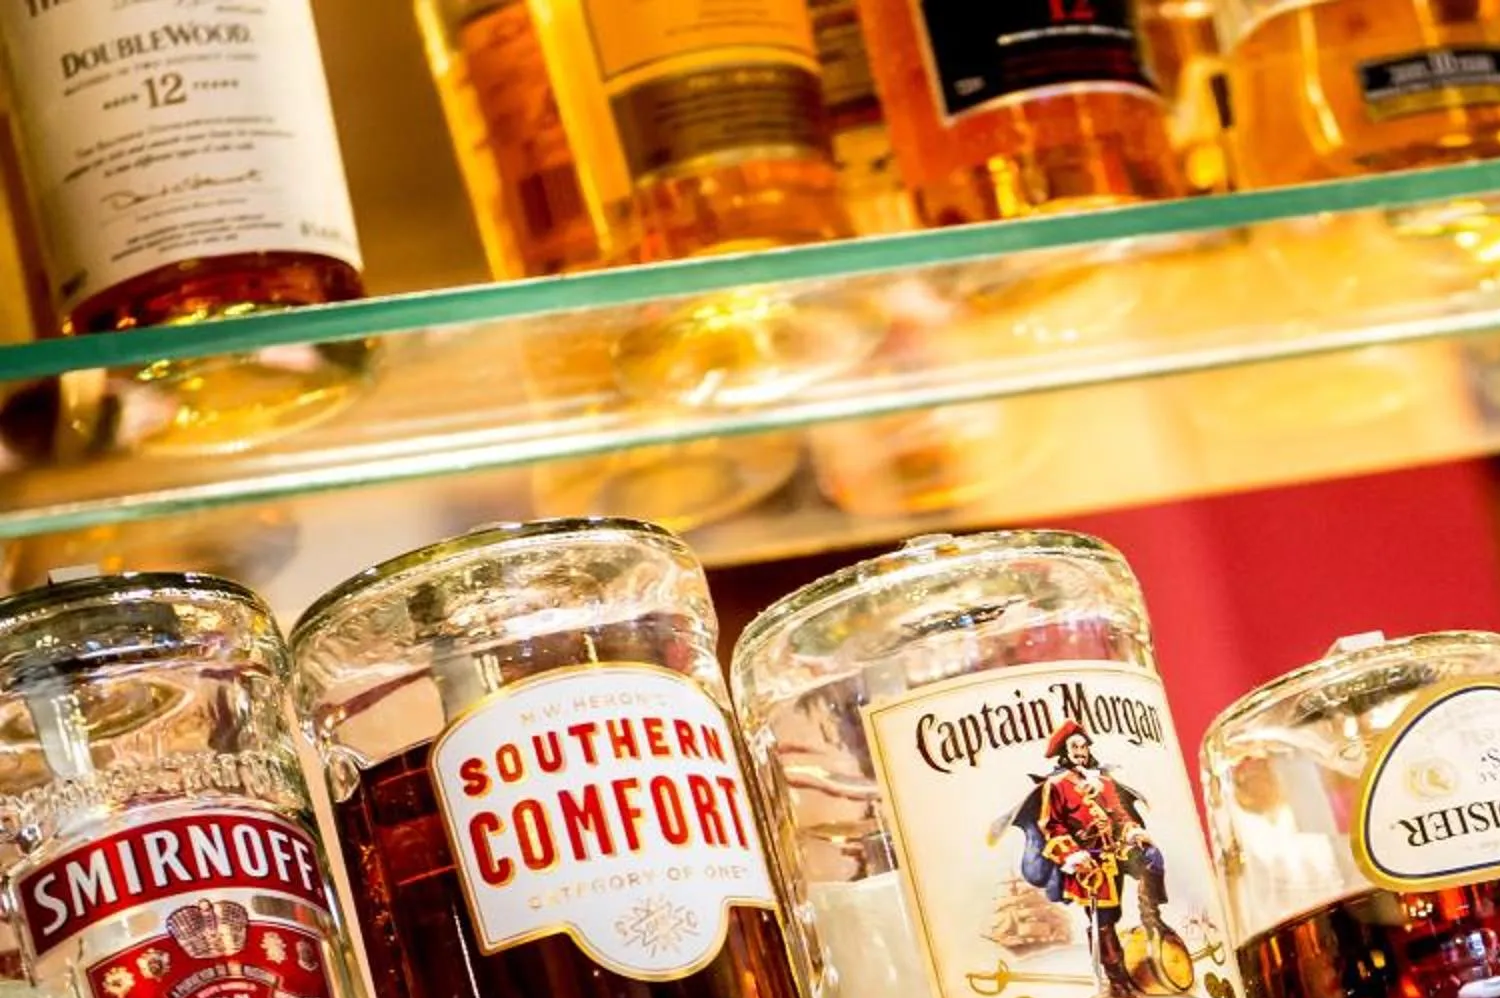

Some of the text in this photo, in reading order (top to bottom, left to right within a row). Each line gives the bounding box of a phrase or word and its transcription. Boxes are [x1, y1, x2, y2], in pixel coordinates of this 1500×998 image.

[142, 72, 187, 110] 12
[459, 717, 728, 797] SOUTHERN
[915, 681, 1165, 775] Captain Morgan
[468, 773, 750, 886] COMFORT
[33, 823, 314, 936] SMIRNOFF
